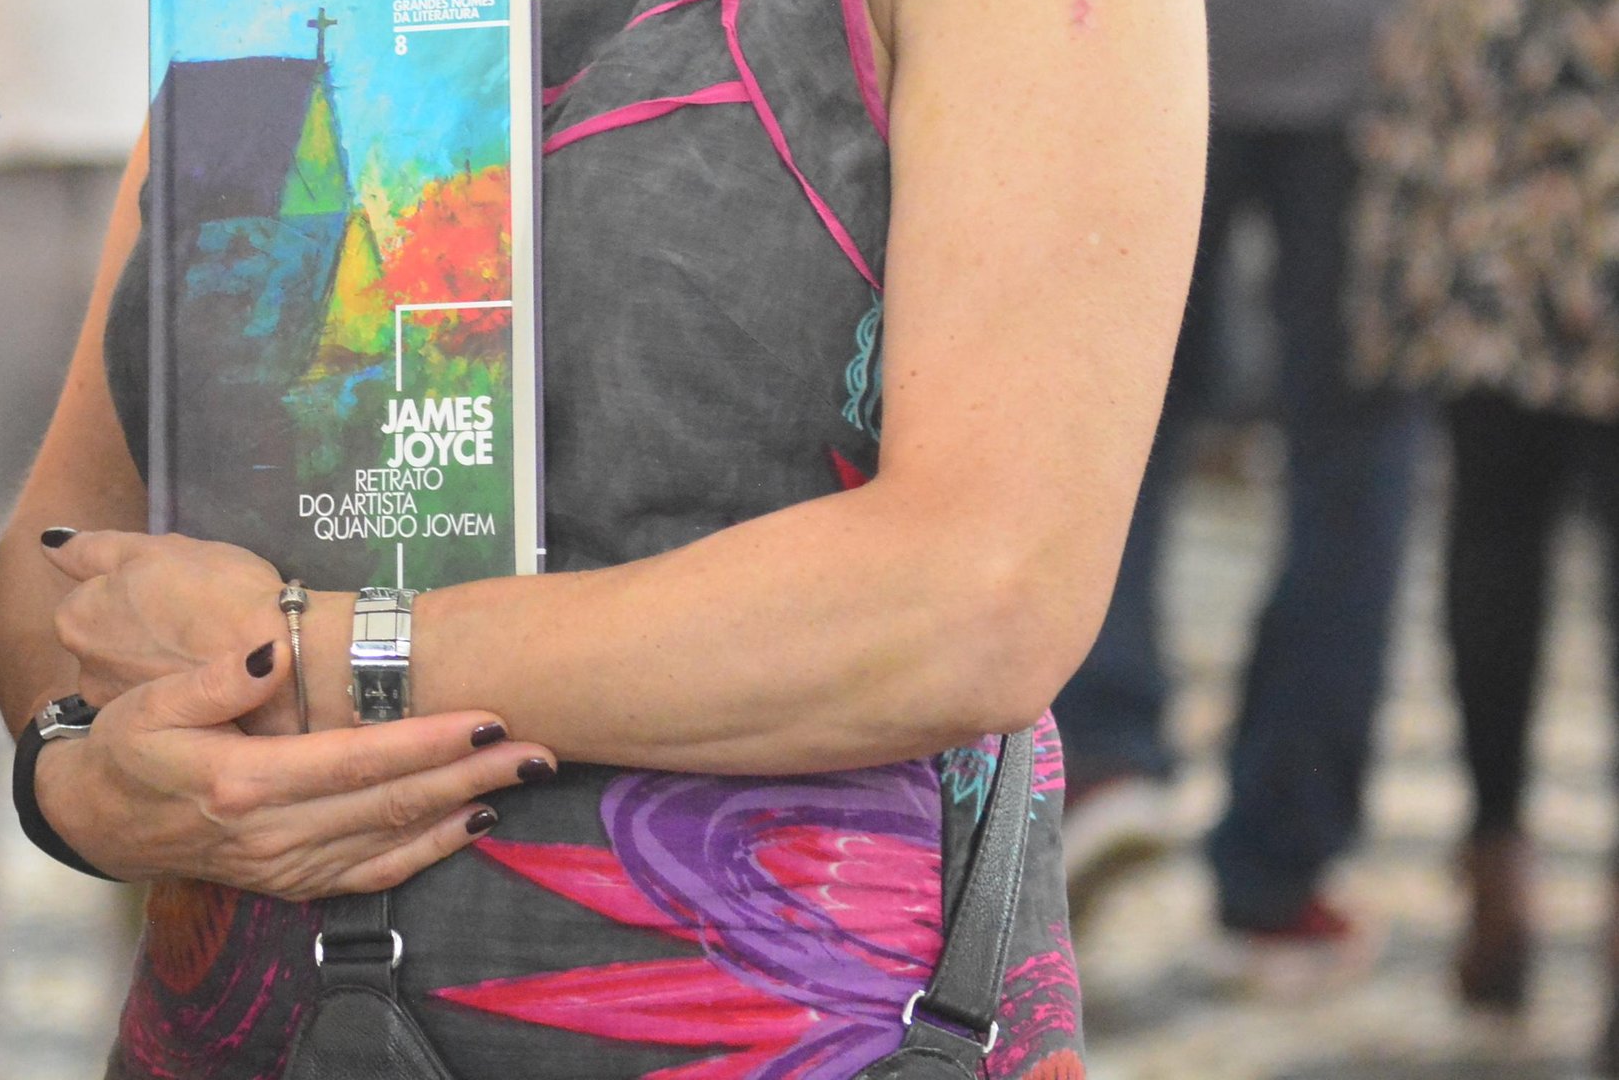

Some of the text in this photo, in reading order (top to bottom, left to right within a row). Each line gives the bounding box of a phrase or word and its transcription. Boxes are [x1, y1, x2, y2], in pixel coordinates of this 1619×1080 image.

[394, 7, 480, 23] DA LITERATURA
[395, 35, 408, 56] 8
[381, 395, 494, 434] JAMES
[387, 431, 494, 468] JOYCE
[355, 467, 443, 492] RETRATO
[299, 491, 418, 517] DO ARTISTA
[314, 513, 496, 541] QUANDO JOVEM
